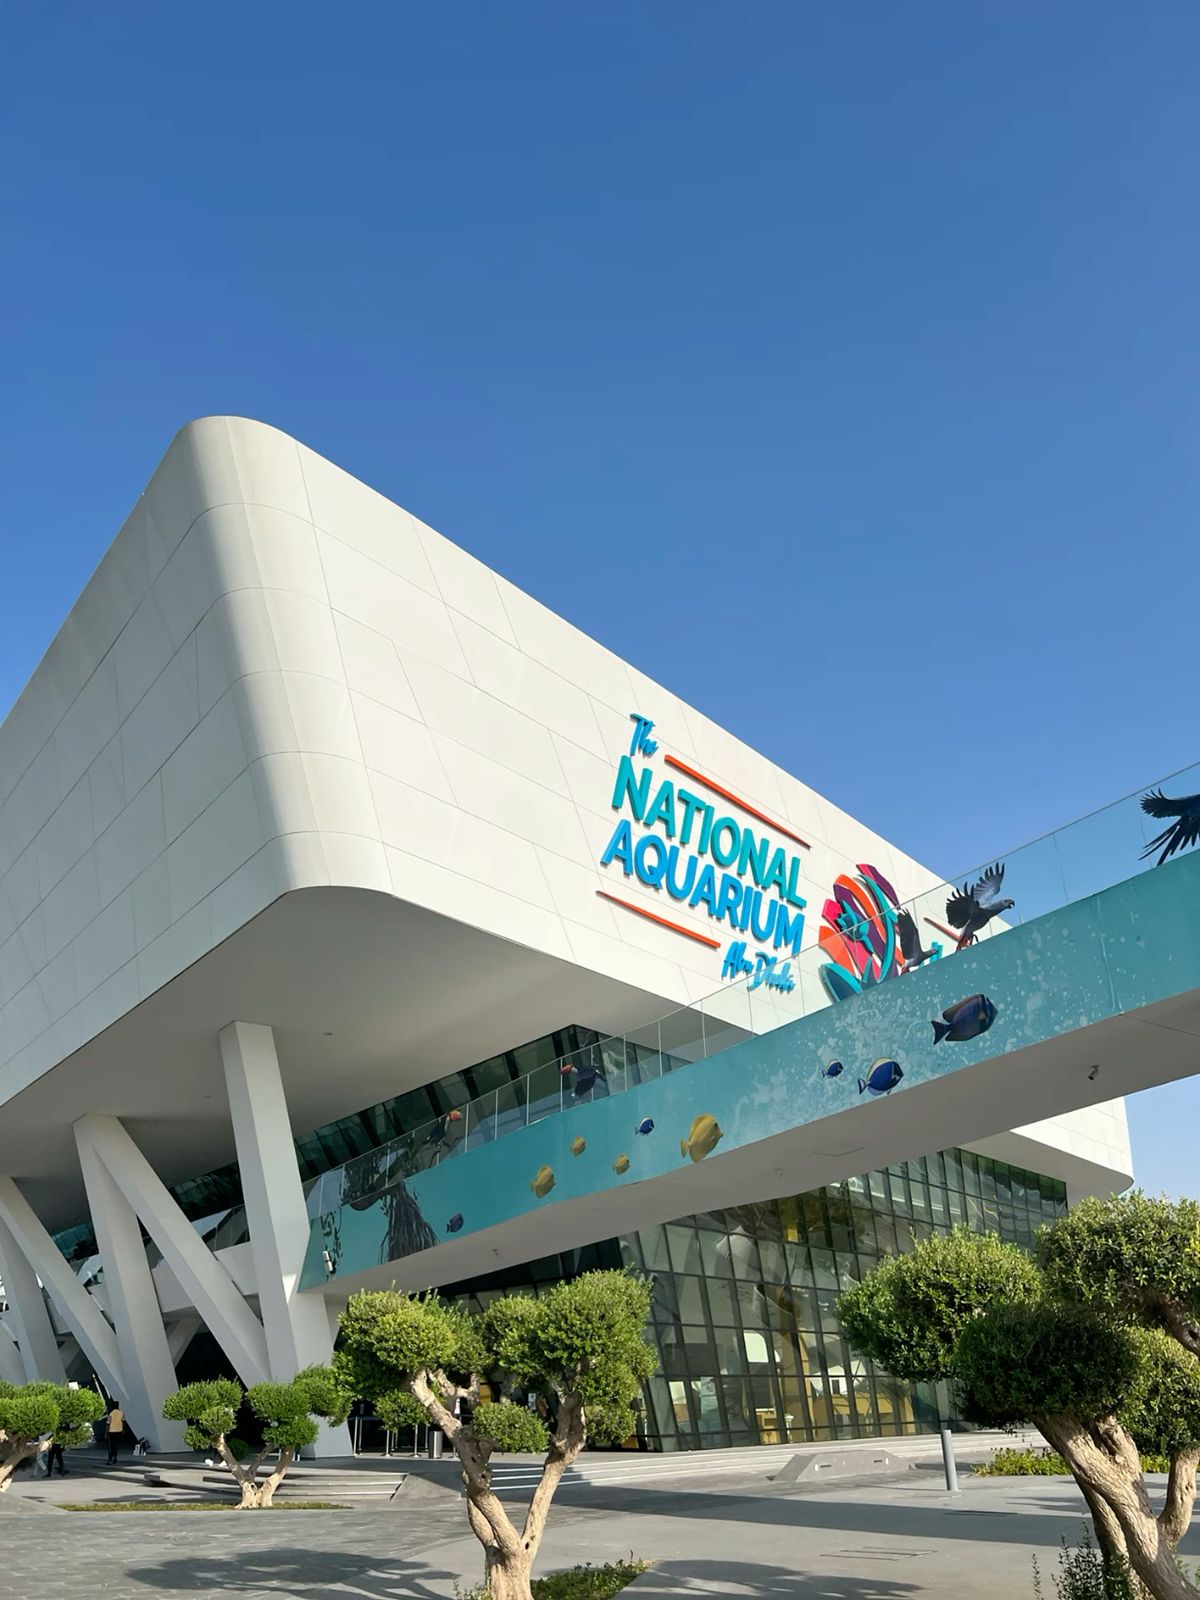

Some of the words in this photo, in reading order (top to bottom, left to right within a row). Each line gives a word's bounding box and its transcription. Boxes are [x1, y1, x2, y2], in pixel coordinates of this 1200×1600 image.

[630, 713, 658, 757] The
[600, 819, 805, 957] AQUARIUM
[611, 755, 807, 909] NATIONAL
